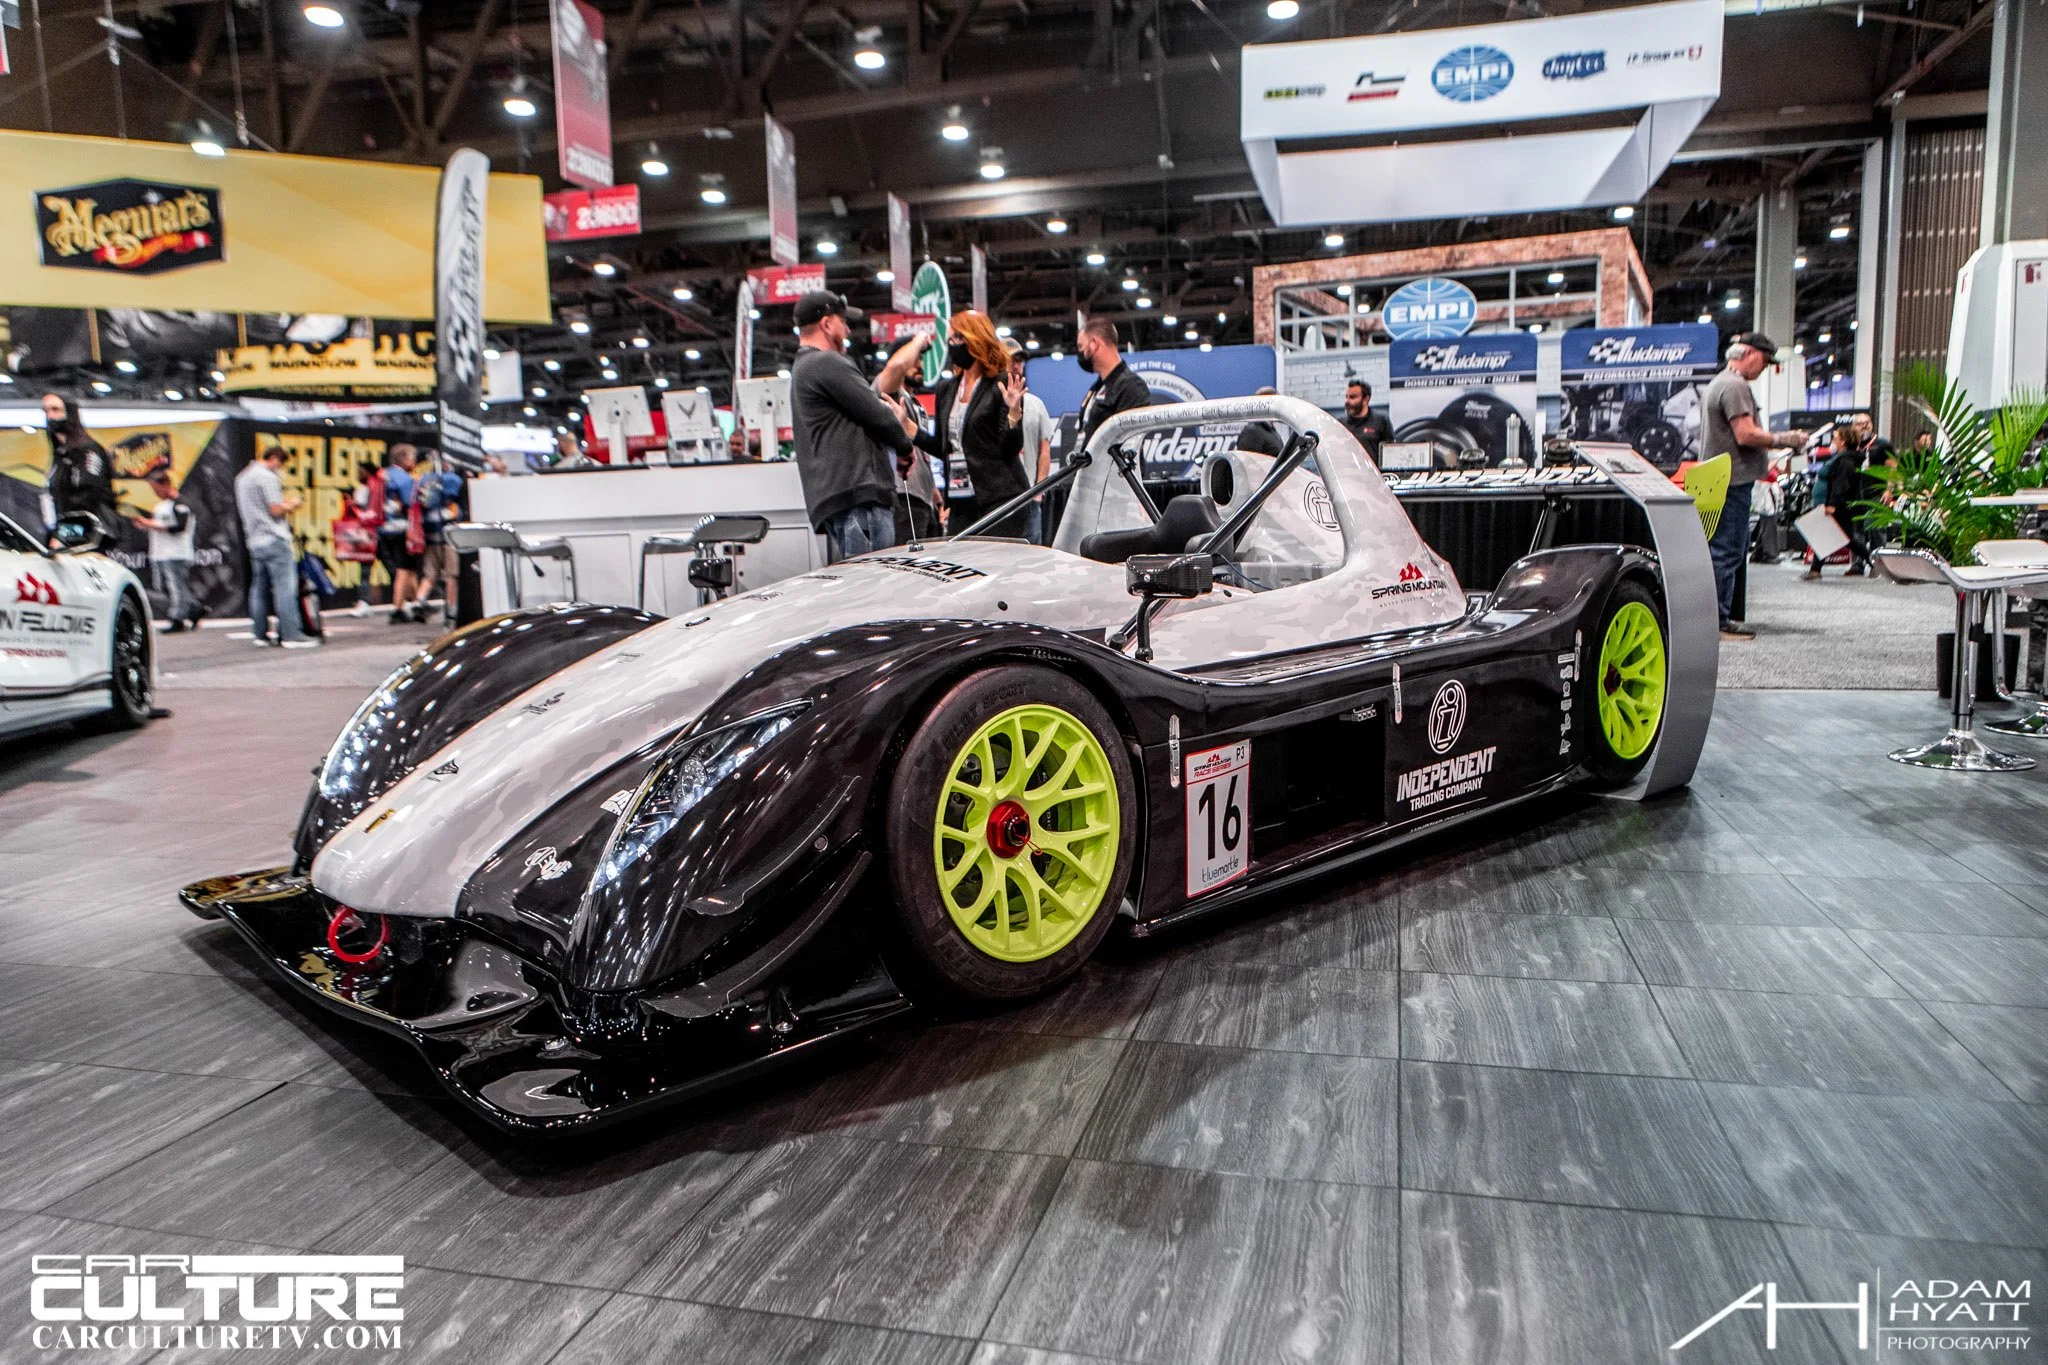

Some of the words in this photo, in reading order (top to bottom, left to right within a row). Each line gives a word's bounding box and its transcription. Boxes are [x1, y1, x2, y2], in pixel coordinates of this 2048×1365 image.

[1436, 62, 1510, 87] EMPI
[1389, 301, 1470, 324] EMPI
[1453, 376, 1486, 386] IMPORT
[1371, 584, 1412, 600] SPRING
[1412, 580, 1447, 592] MOUNTAIN
[20, 611, 96, 635] FELLOWS
[982, 683, 1027, 710] SPORT
[1236, 746, 1245, 761] P3
[1194, 768, 1212, 777] RACE
[1212, 762, 1232, 773] SERIES
[1396, 746, 1497, 802] INDEPENDENT
[1410, 789, 1444, 811] TRADING
[1445, 777, 1483, 798] COMPANY
[1199, 774, 1241, 860] 16
